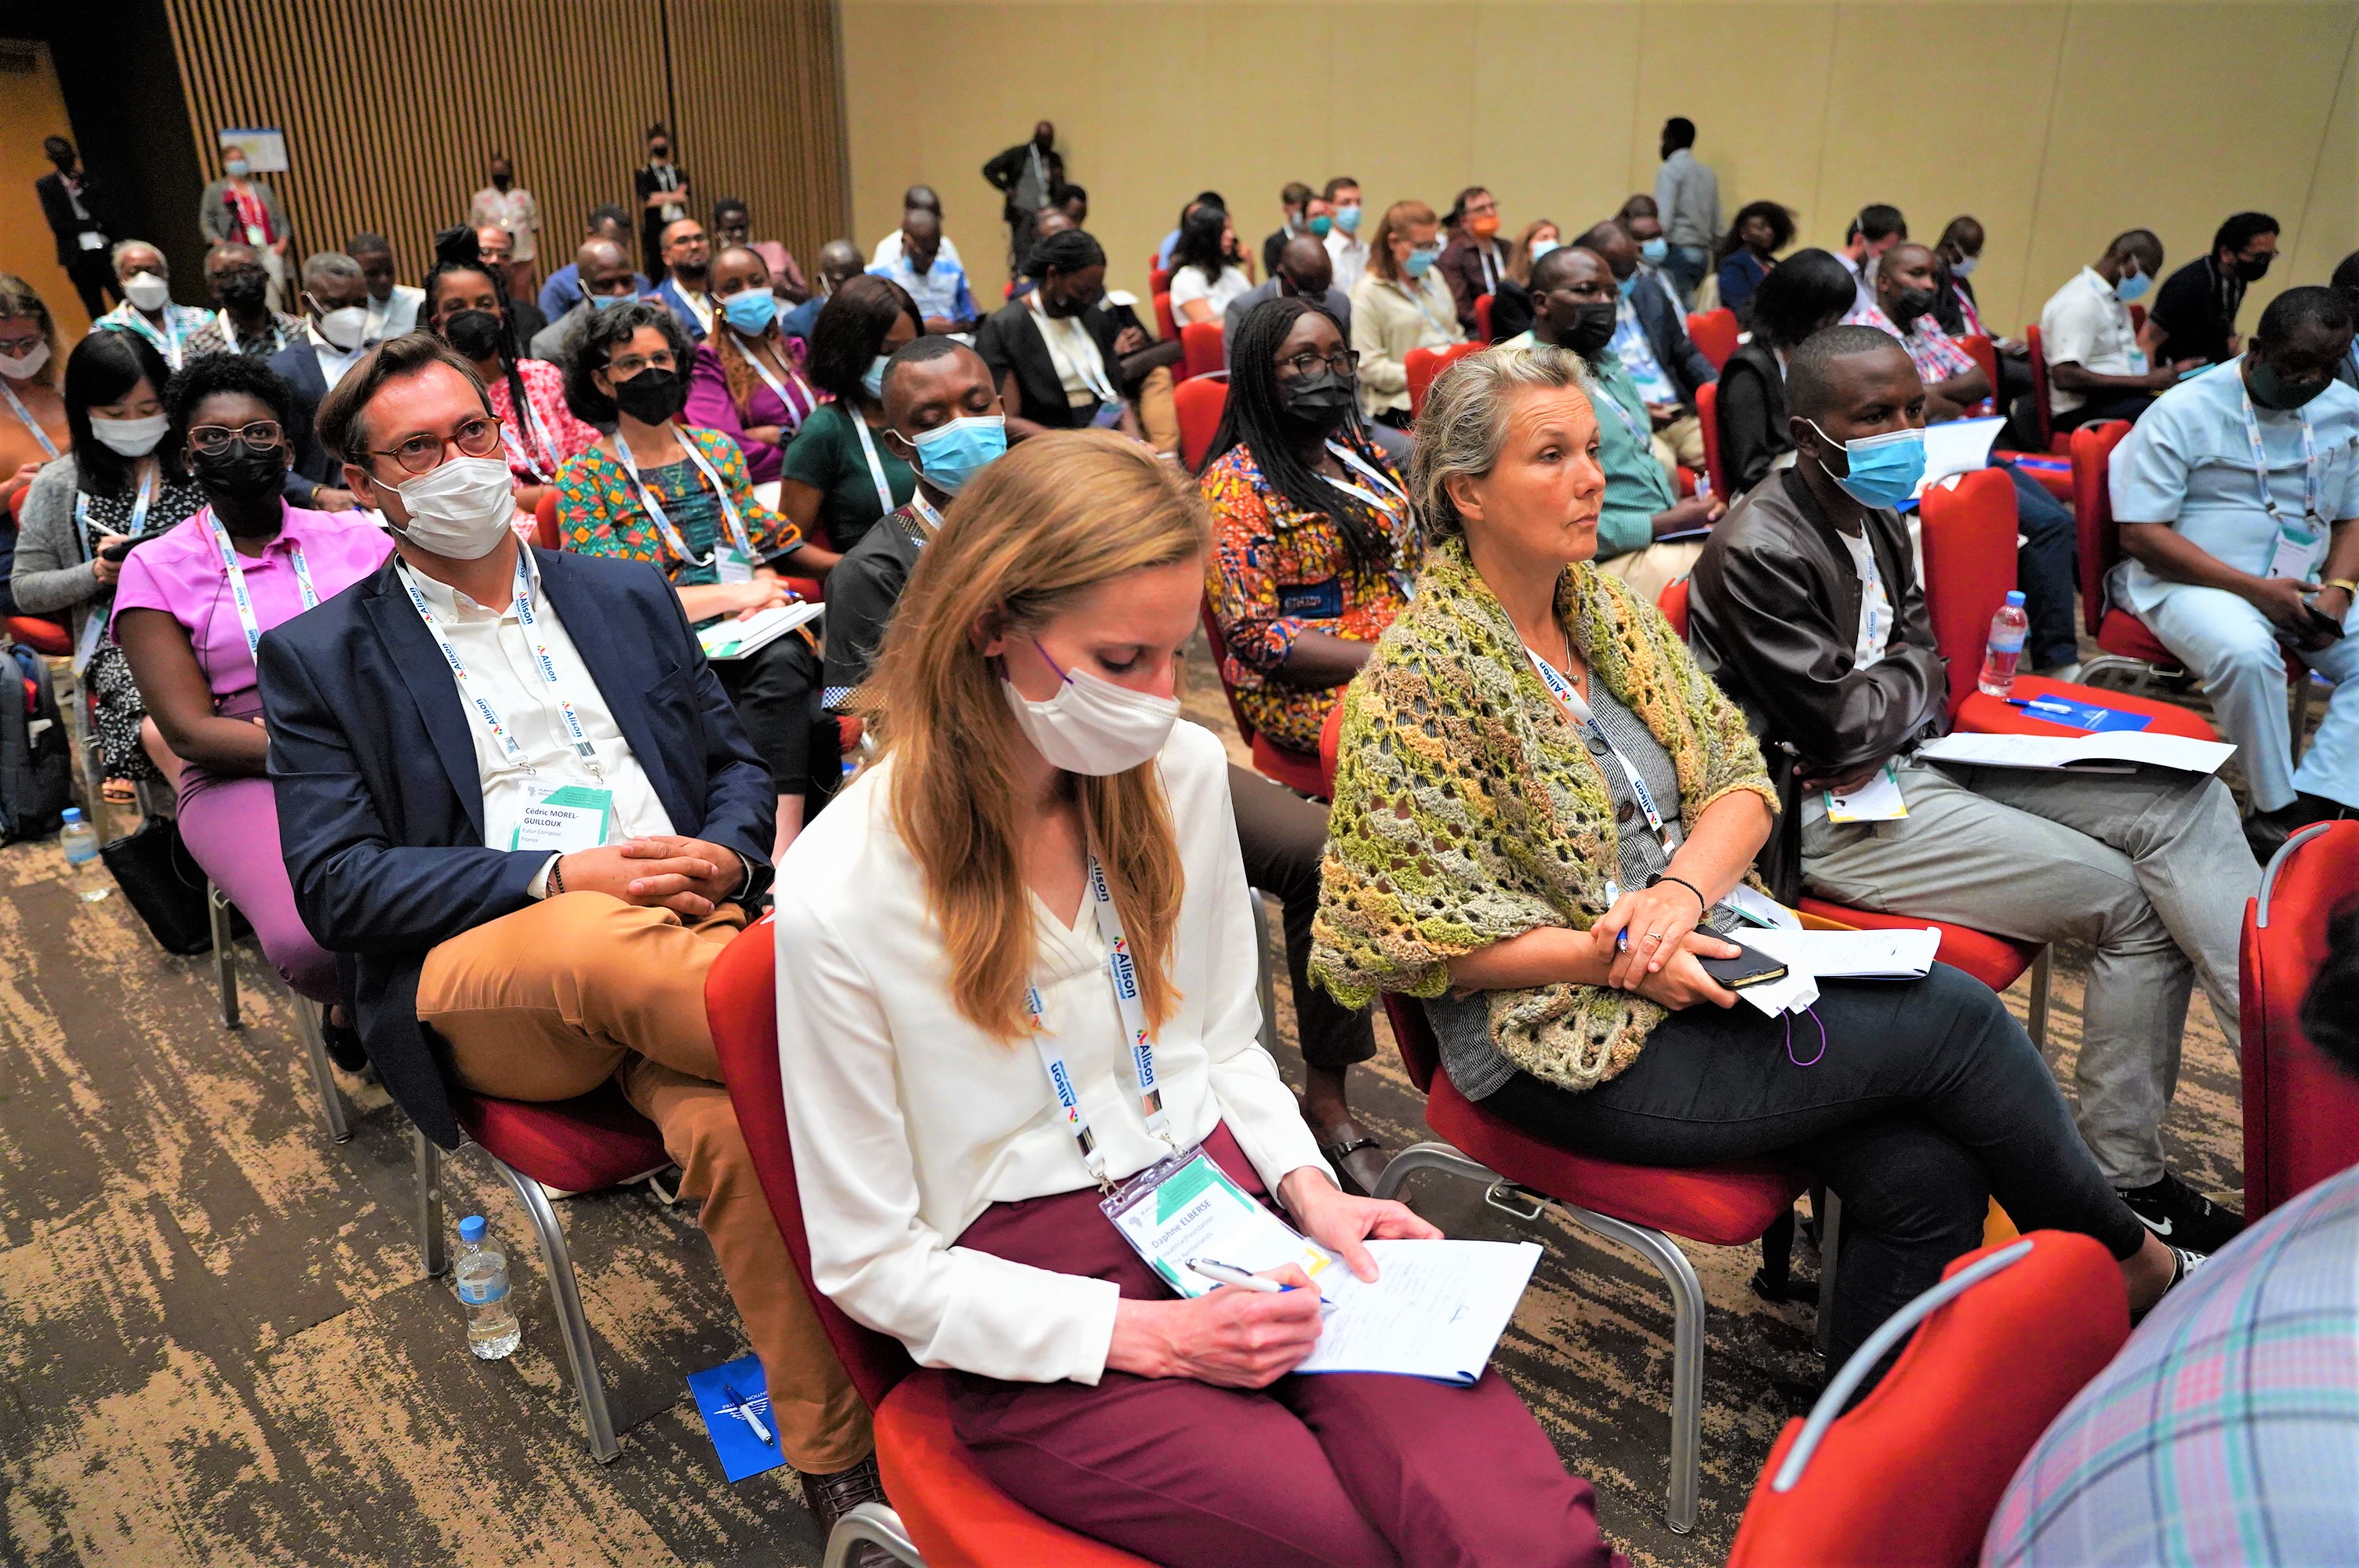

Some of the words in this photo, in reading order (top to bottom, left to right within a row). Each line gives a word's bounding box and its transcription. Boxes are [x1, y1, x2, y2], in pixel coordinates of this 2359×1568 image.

[409, 587, 428, 614] Alison
[521, 598, 533, 625] Alison
[442, 643, 460, 670] Alison
[541, 655, 557, 682] Alison
[1539, 662, 1564, 693] Alison
[476, 699, 497, 725] Alison
[565, 710, 582, 738] Alison
[1634, 781, 1653, 813] Alison
[524, 818, 562, 827] GUILLOUX
[525, 808, 548, 816] Cédric
[550, 810, 579, 818] MOREL-
[1110, 953, 1122, 979] Empower
[1117, 953, 1136, 999] Alison
[1115, 977, 1127, 1000] yourself
[1133, 1047, 1142, 1069] Empower
[1140, 1045, 1154, 1085] Alison
[1050, 1063, 1073, 1107] Alison
[1151, 1223, 1181, 1248] Daphne
[1180, 1199, 1212, 1226] ELBERSE
[1181, 1232, 1213, 1258] Netherlands
